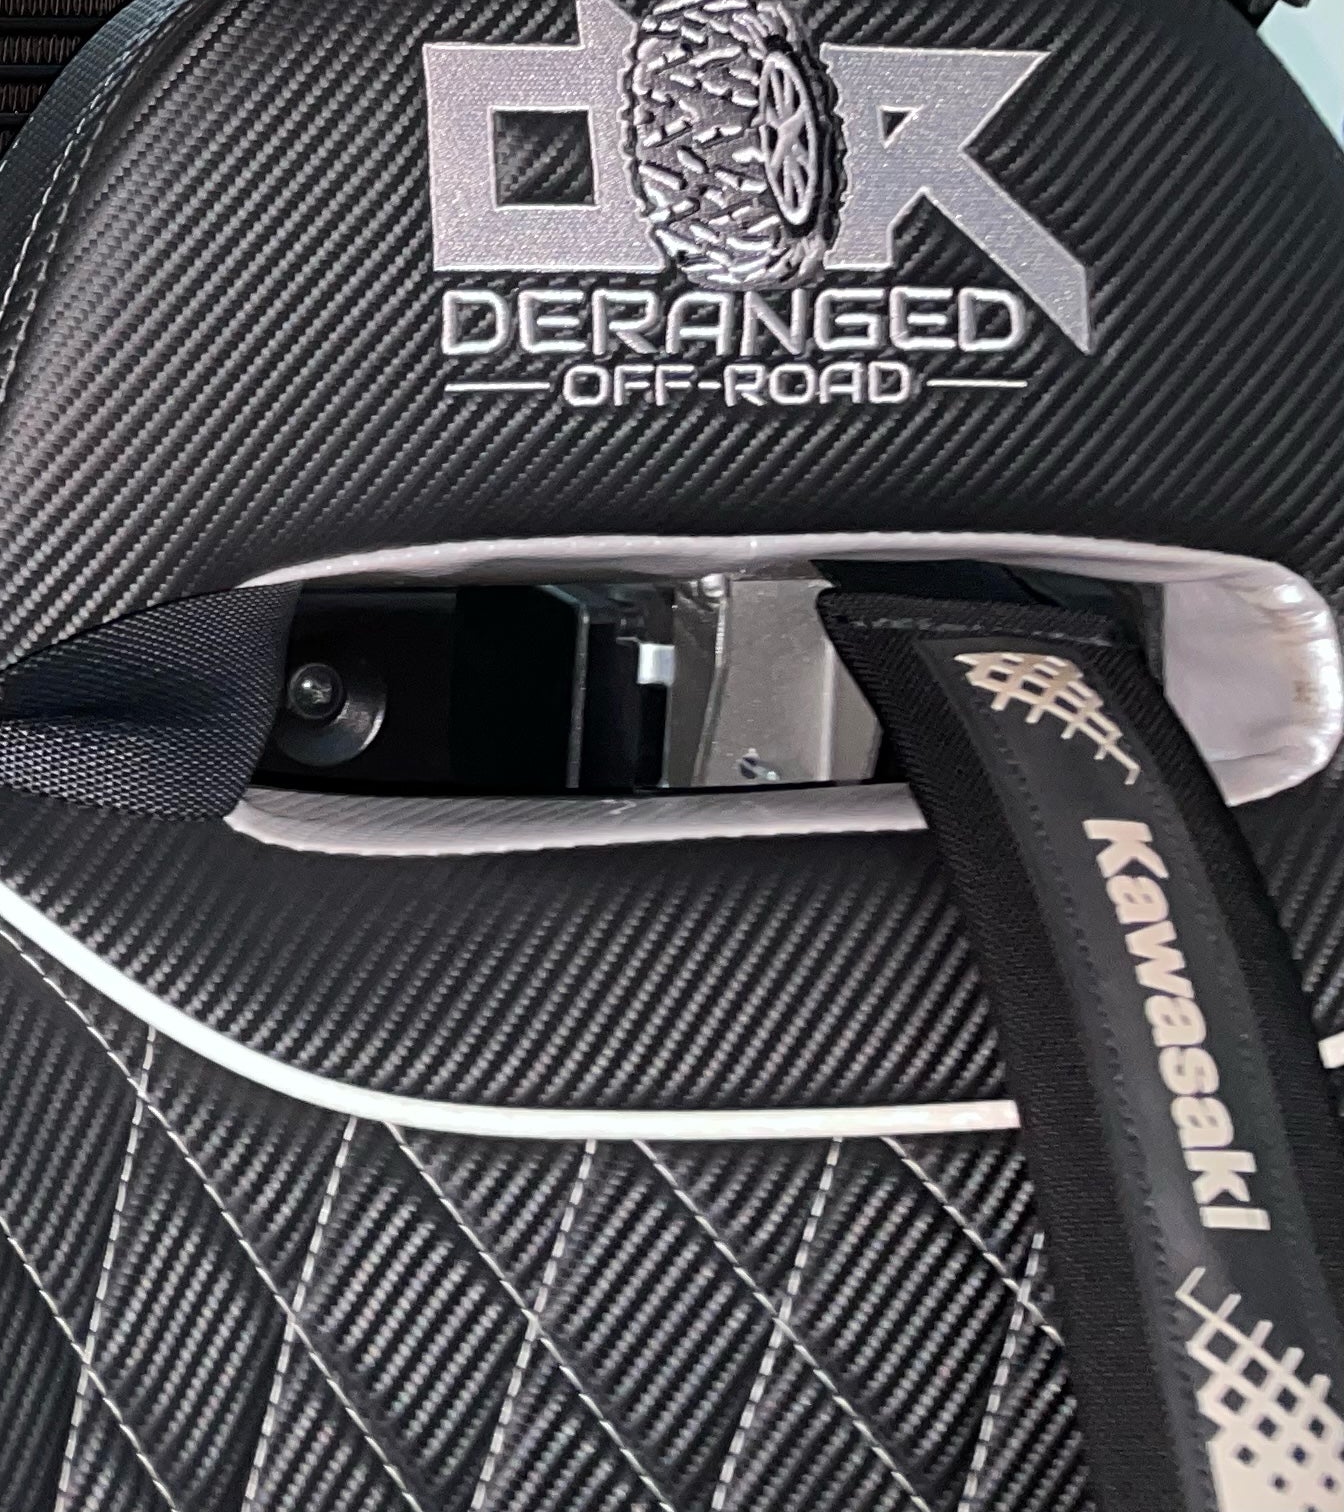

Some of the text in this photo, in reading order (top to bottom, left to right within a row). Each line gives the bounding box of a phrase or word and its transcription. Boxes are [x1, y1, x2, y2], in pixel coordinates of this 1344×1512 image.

[441, 287, 1025, 356] DERANGED
[562, 361, 914, 408] OFF-ROAD
[1083, 819, 1270, 1231] Kawasaki
